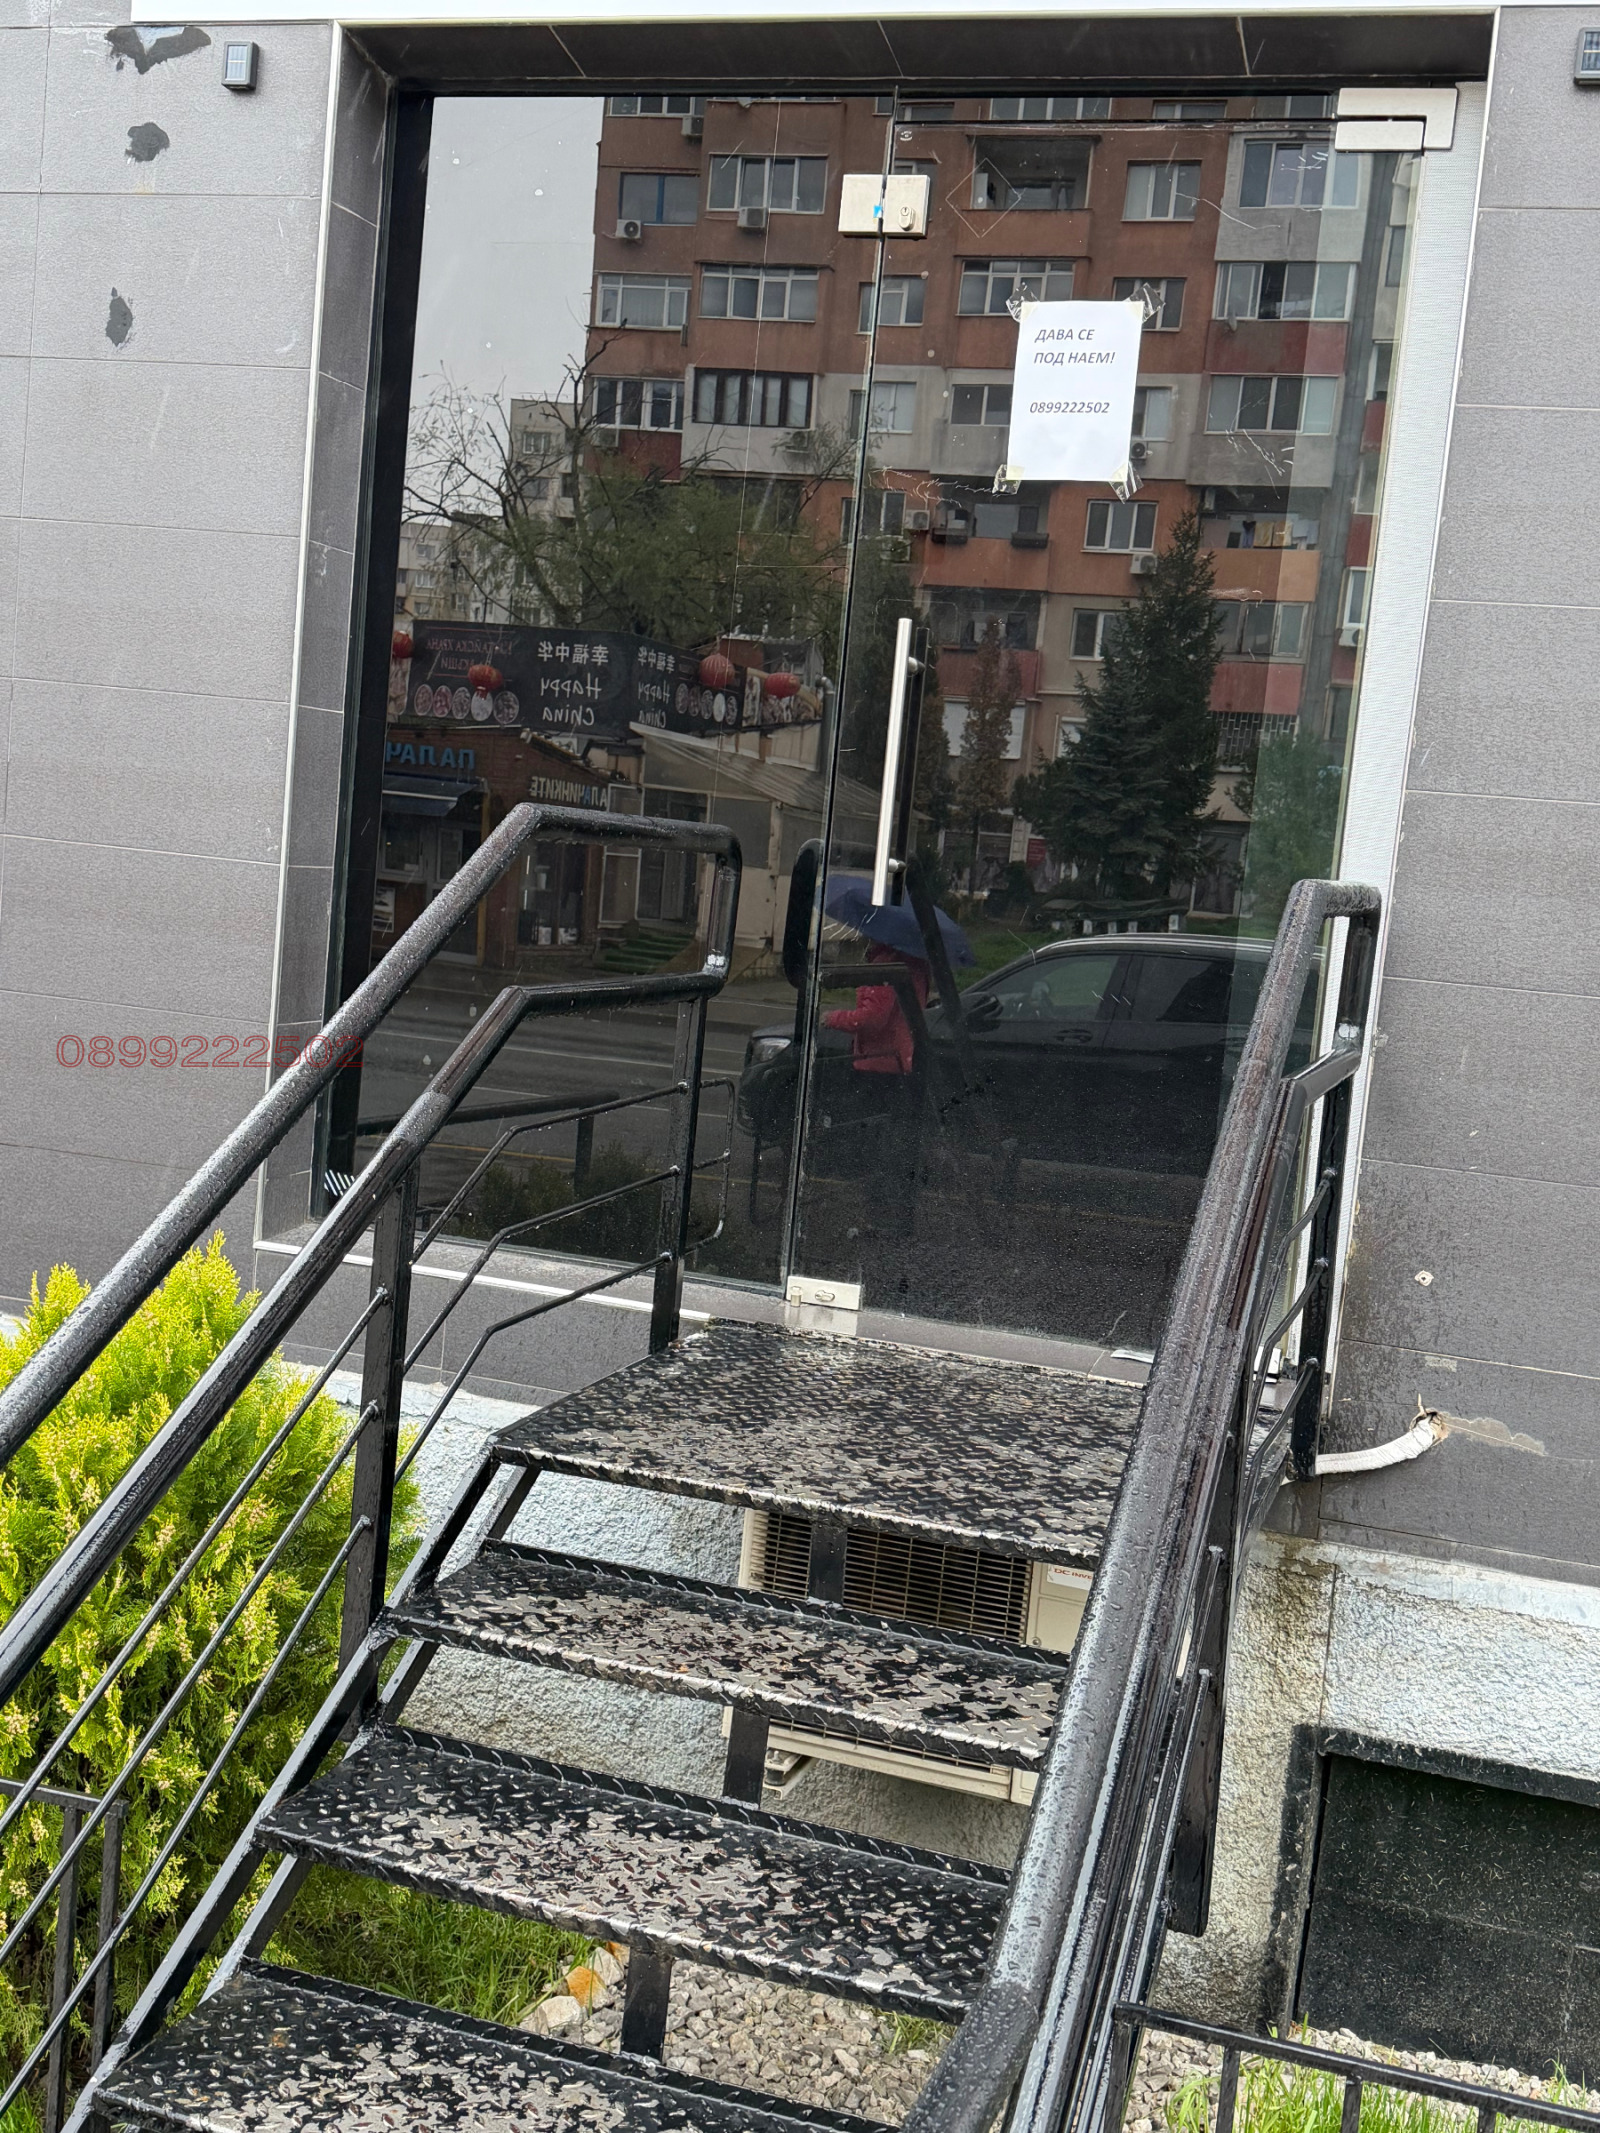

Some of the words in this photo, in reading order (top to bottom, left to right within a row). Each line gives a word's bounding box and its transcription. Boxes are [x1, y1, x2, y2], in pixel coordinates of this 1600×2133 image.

[1034, 329, 1074, 343] ДАВА
[1078, 329, 1095, 341] СЕ
[1033, 352, 1064, 366] ПОД
[1068, 352, 1116, 364] НАЕМ!
[1029, 402, 1110, 414] 0899222502
